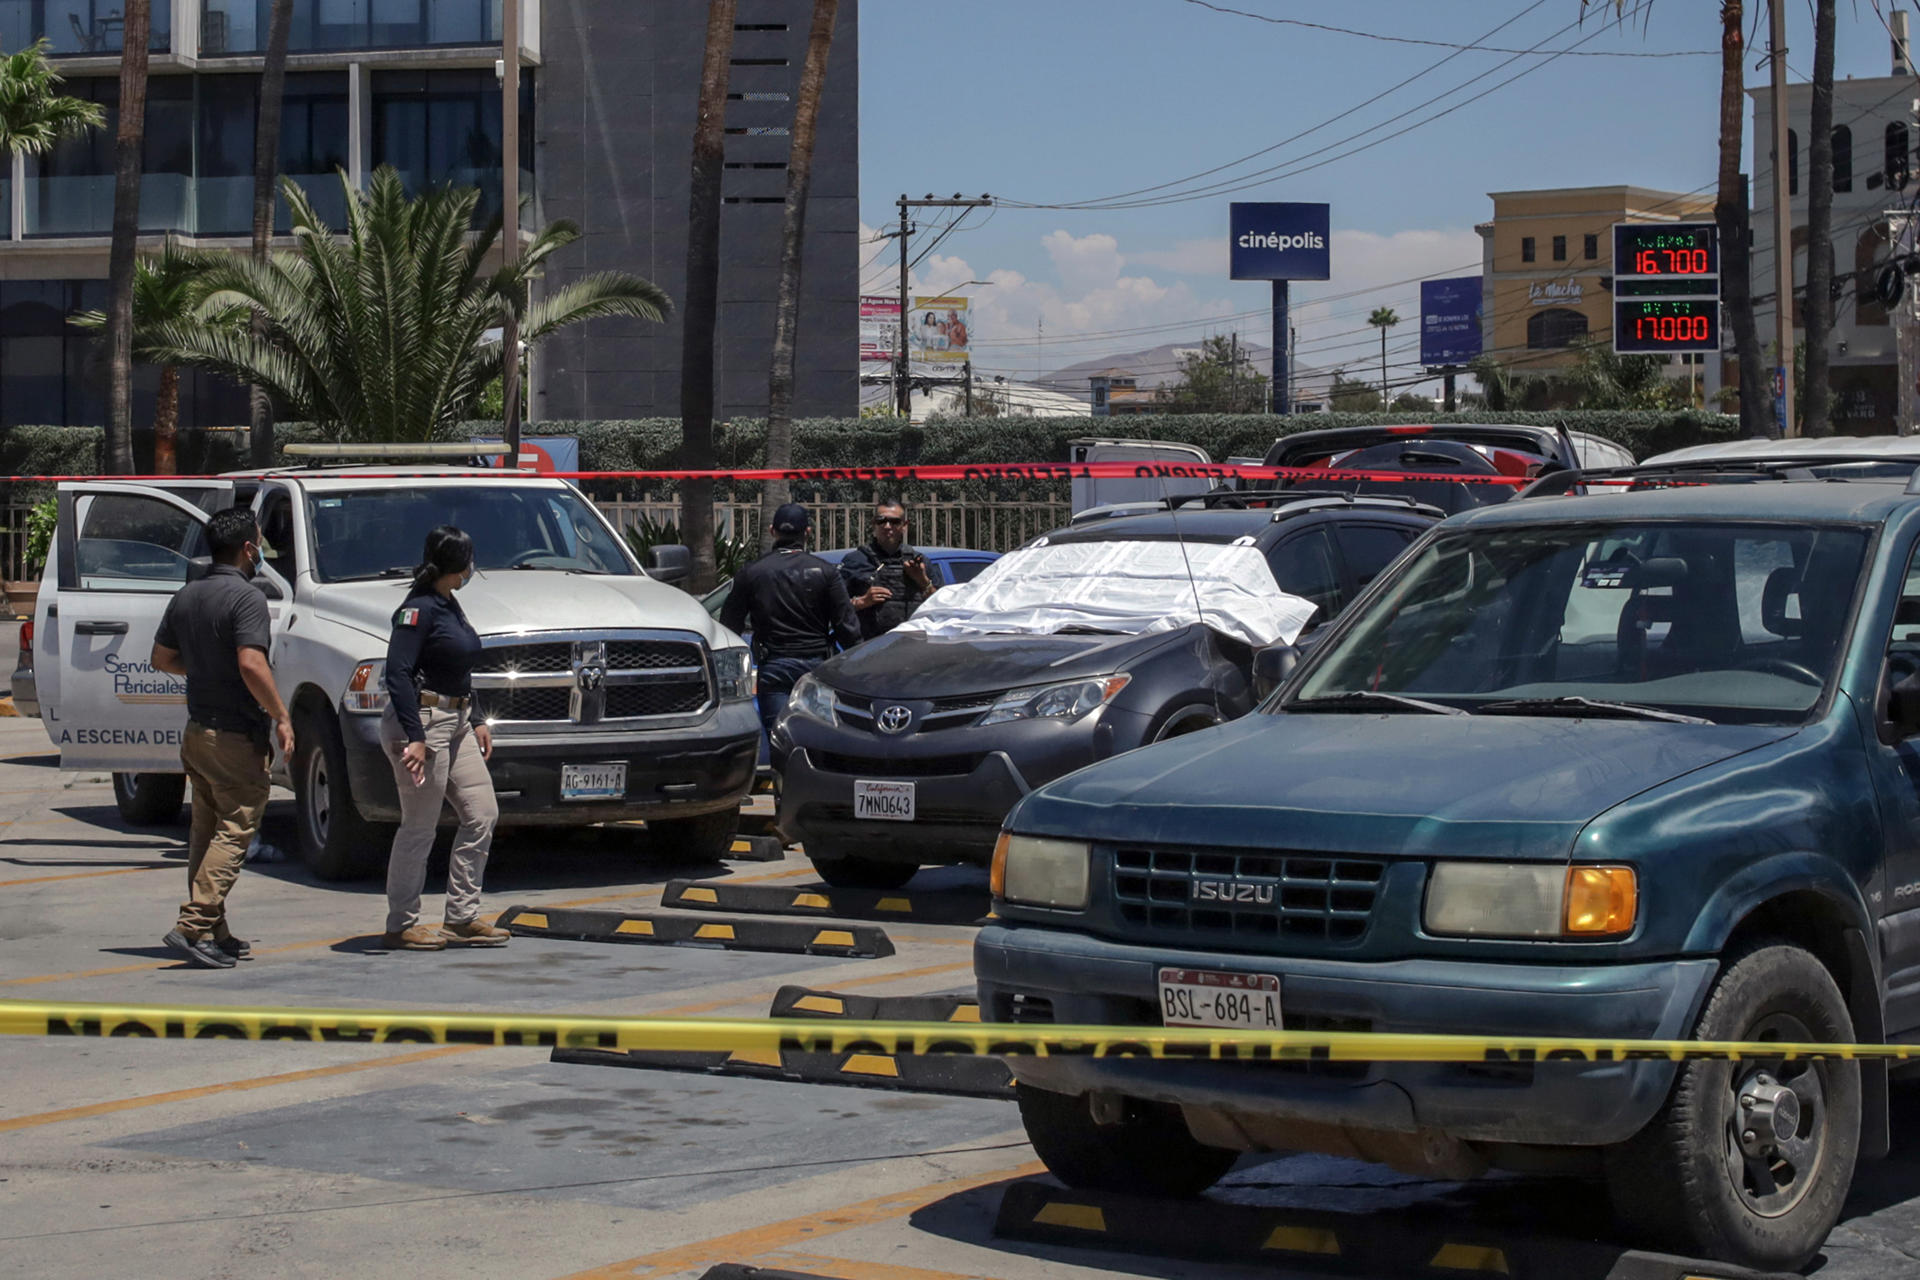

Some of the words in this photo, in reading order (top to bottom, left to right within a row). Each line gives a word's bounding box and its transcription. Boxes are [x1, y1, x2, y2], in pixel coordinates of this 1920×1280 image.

[1239, 230, 1324, 251] cinépolis
[1636, 249, 1708, 274] 16.700
[1637, 316, 1709, 341] 17.000
[114, 674, 187, 695] Periciales
[60, 729, 73, 744] A
[77, 729, 148, 744] ESCENA
[1193, 880, 1273, 903] ISUZU
[1164, 988, 1277, 1027] BSL-684-A
